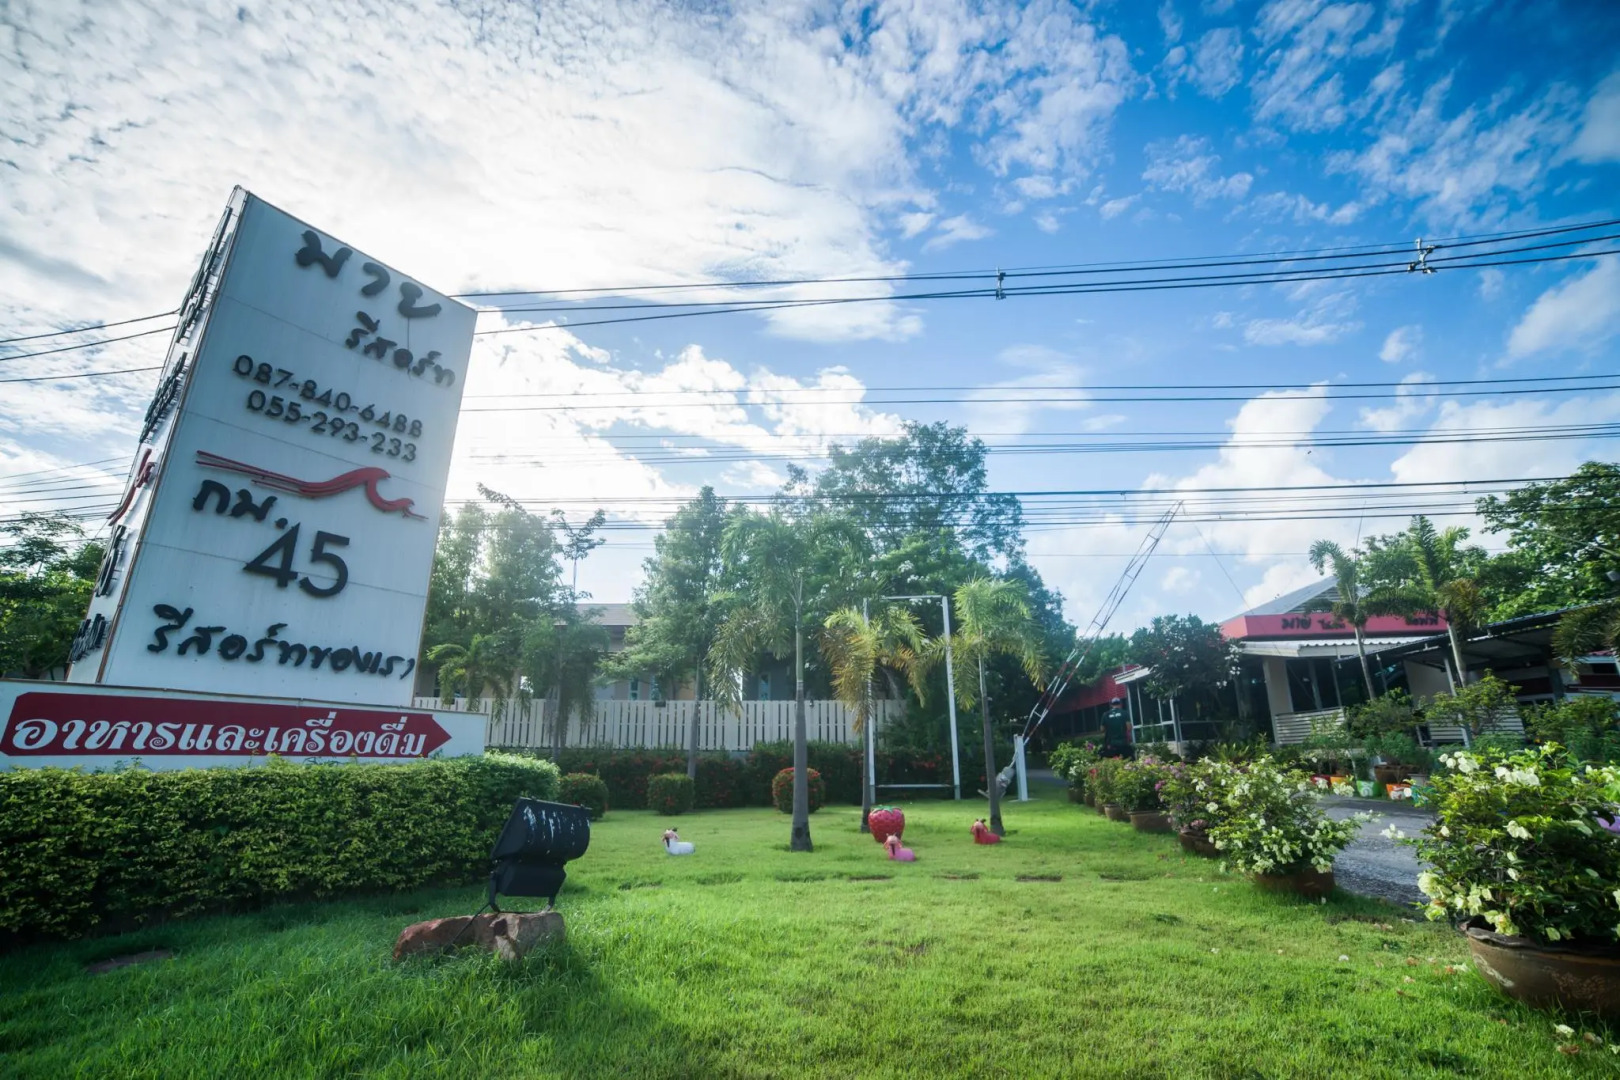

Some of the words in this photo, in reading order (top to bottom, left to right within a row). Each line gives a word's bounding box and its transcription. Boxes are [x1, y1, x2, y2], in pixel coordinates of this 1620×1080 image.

[233, 354, 423, 438] 087-840-6488
[247, 389, 417, 462] 055-293-233
[193, 479, 288, 529] กม.
[243, 522, 350, 598] 45
[147, 603, 415, 680] รีสอร์ทของเรา
[12, 712, 427, 756] อาหารและเครื่องดื่ม
